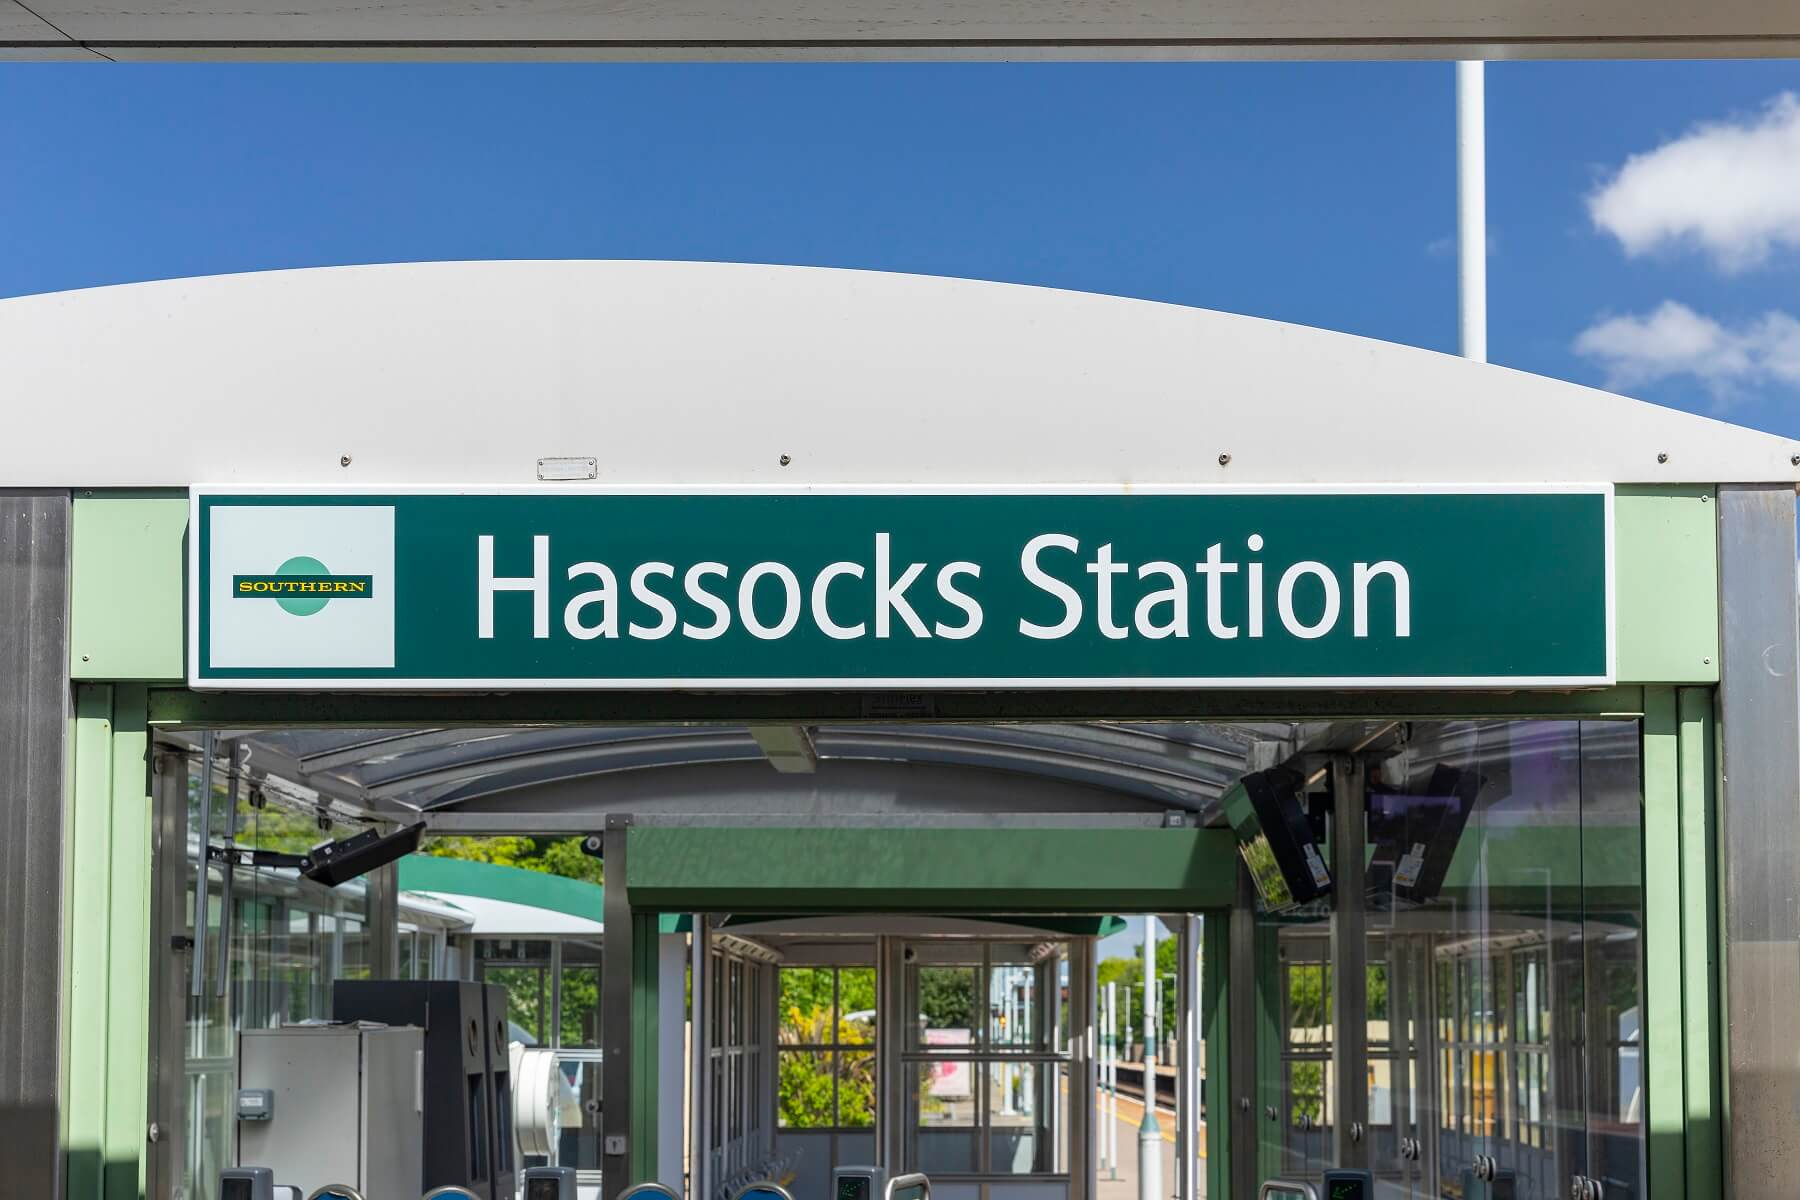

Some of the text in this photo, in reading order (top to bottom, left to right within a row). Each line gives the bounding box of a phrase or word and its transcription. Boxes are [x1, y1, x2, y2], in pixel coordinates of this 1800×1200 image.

[239, 581, 366, 593] SOUTHERN
[478, 532, 1410, 640] Hassocks Station
